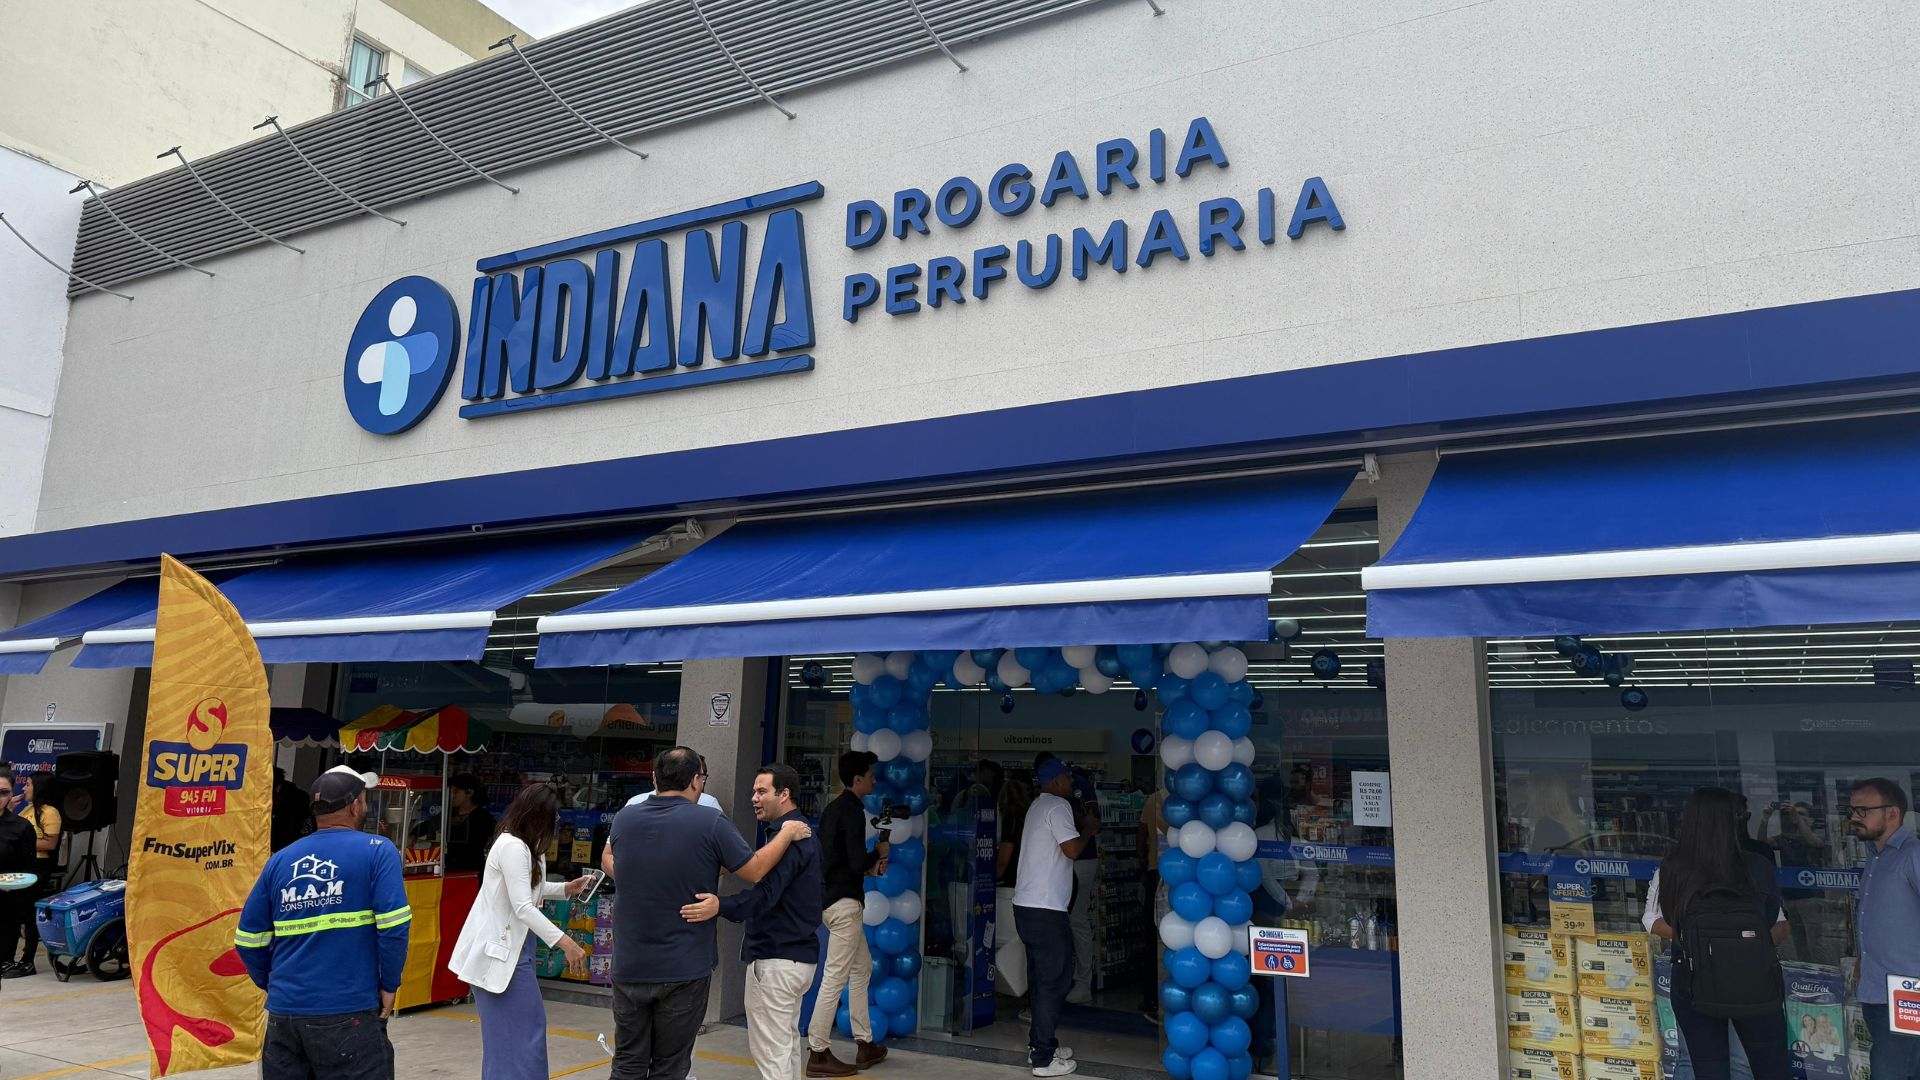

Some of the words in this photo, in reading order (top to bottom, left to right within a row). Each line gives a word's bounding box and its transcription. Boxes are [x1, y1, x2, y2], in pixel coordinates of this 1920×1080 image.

[845, 116, 1230, 251] DROGARIA
[842, 176, 1346, 323] PERFUMARIA
[461, 207, 816, 400] INDIANA
[1493, 714, 1668, 735] edicamentos
[1003, 734, 1053, 745] vitaminas
[154, 752, 240, 783] SUPER
[143, 837, 236, 863] FmSuperVix
[1316, 847, 1348, 861] INDIANA
[1591, 860, 1629, 876] INDIANA
[1556, 882, 1581, 891] SUPER
[1815, 871, 1860, 888] INDIANA
[281, 881, 344, 904] M.A.M
[1552, 889, 1585, 897] OFERTAS
[1554, 949, 1565, 958] 16
[1635, 957, 1646, 967] 16
[1558, 1007, 1569, 1017] 16
[1638, 1015, 1649, 1025] 16
[1664, 1048, 1675, 1056] 30
[1561, 1066, 1571, 1076] 16
